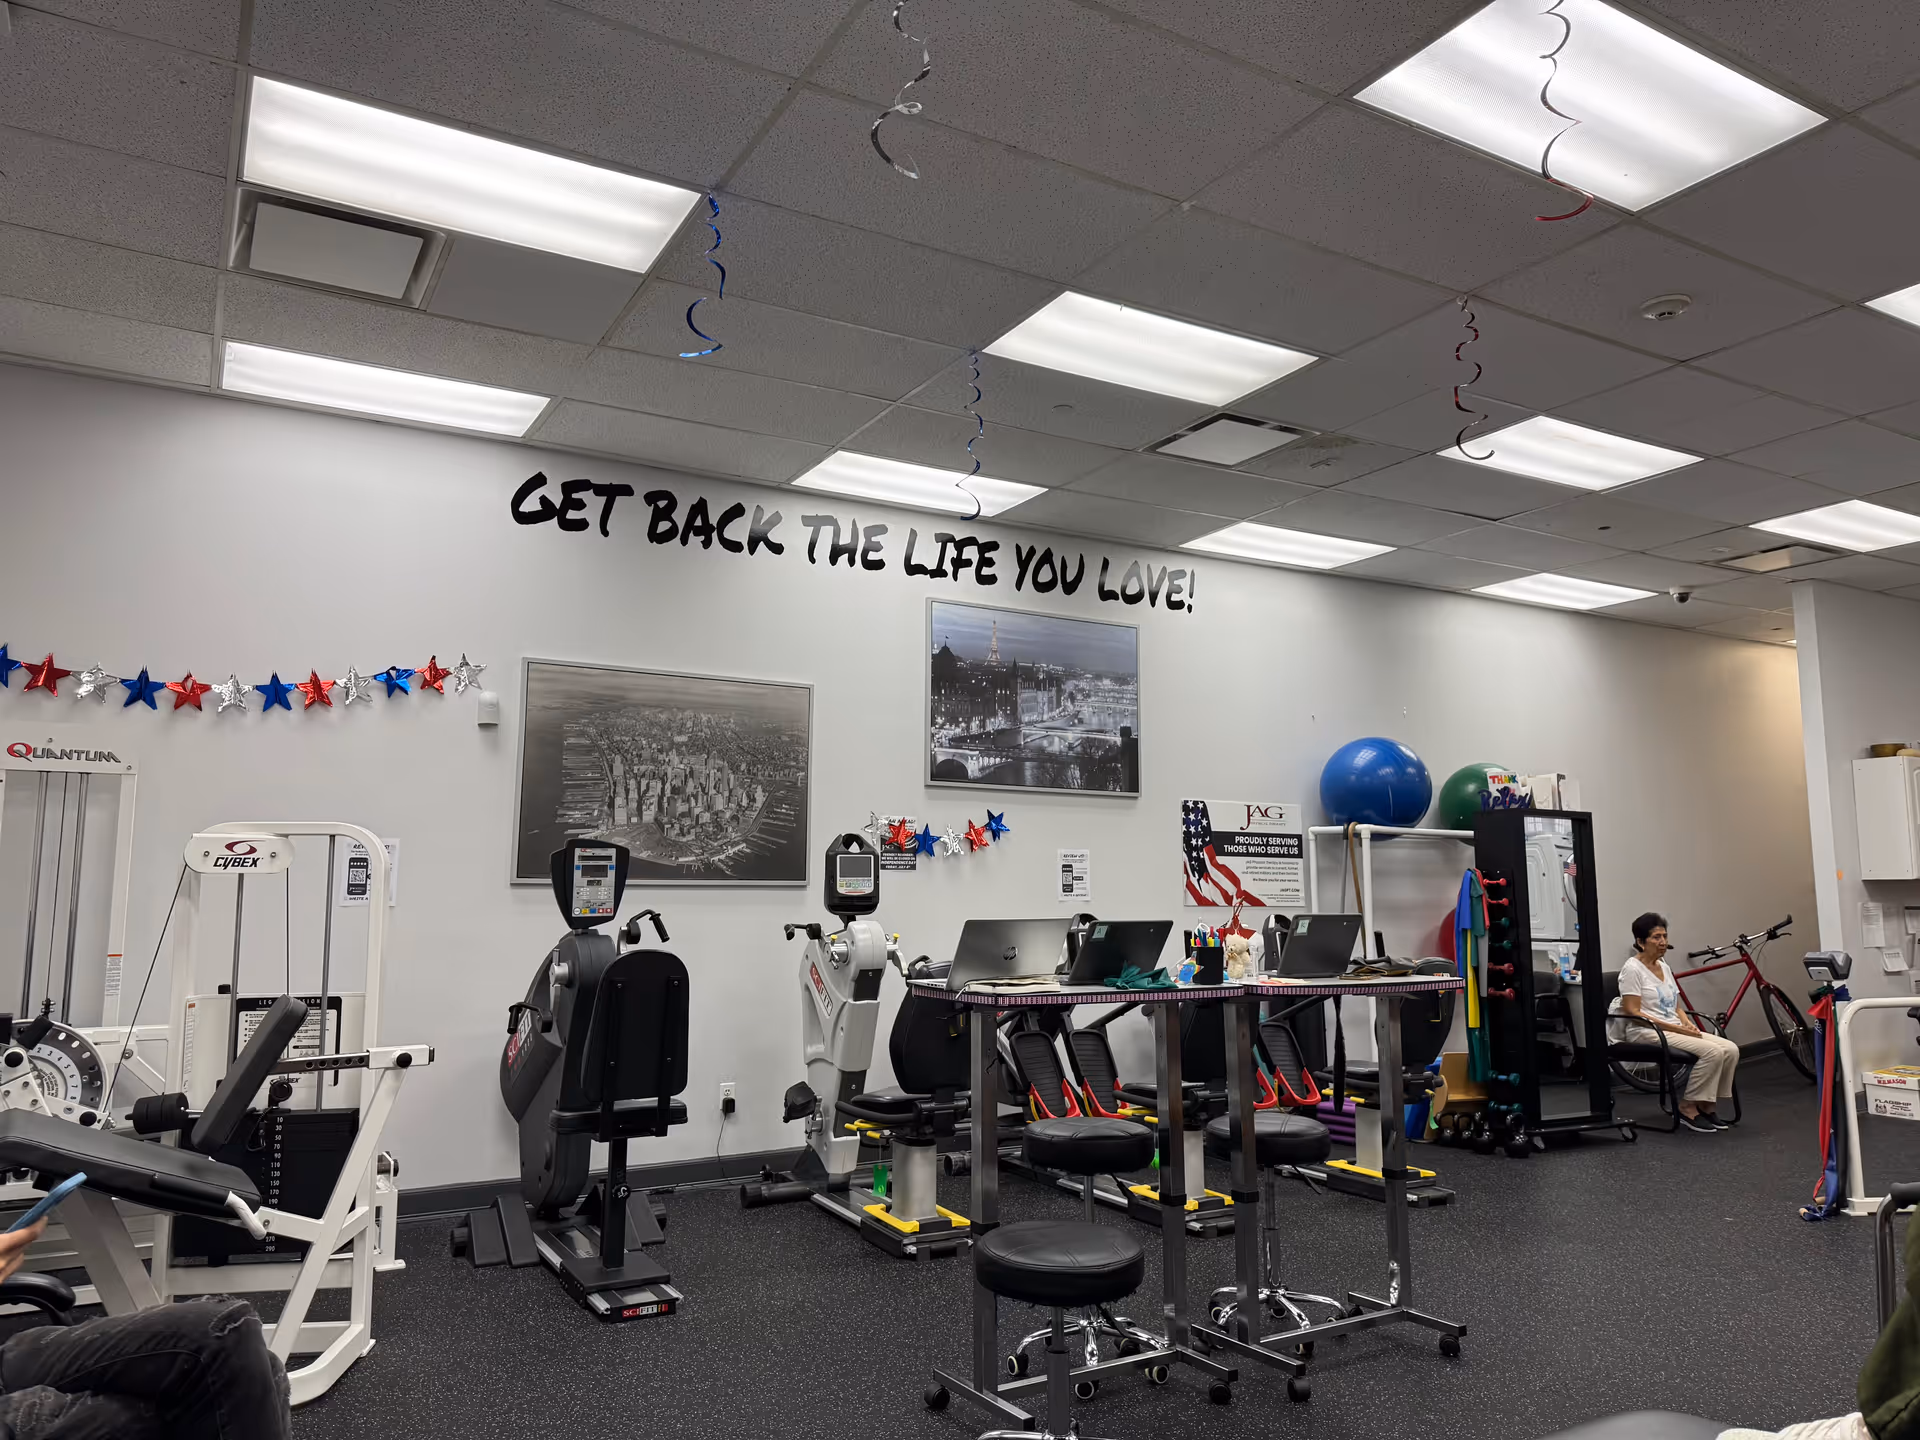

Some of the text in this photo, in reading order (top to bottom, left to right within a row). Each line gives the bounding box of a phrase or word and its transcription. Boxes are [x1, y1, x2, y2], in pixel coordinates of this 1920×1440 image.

[511, 471, 1196, 614] GET BACK THE LIFE YOU LOVE!
[6, 742, 121, 763] QUANTUM
[1489, 774, 1518, 785] THANK
[1240, 804, 1286, 831] JAG
[1235, 836, 1299, 846] PROUDLY SERVING
[1223, 845, 1299, 855] THOSE WHO SERVE US
[213, 857, 260, 870] CYBEX
[623, 1305, 657, 1317] SCIFIT
